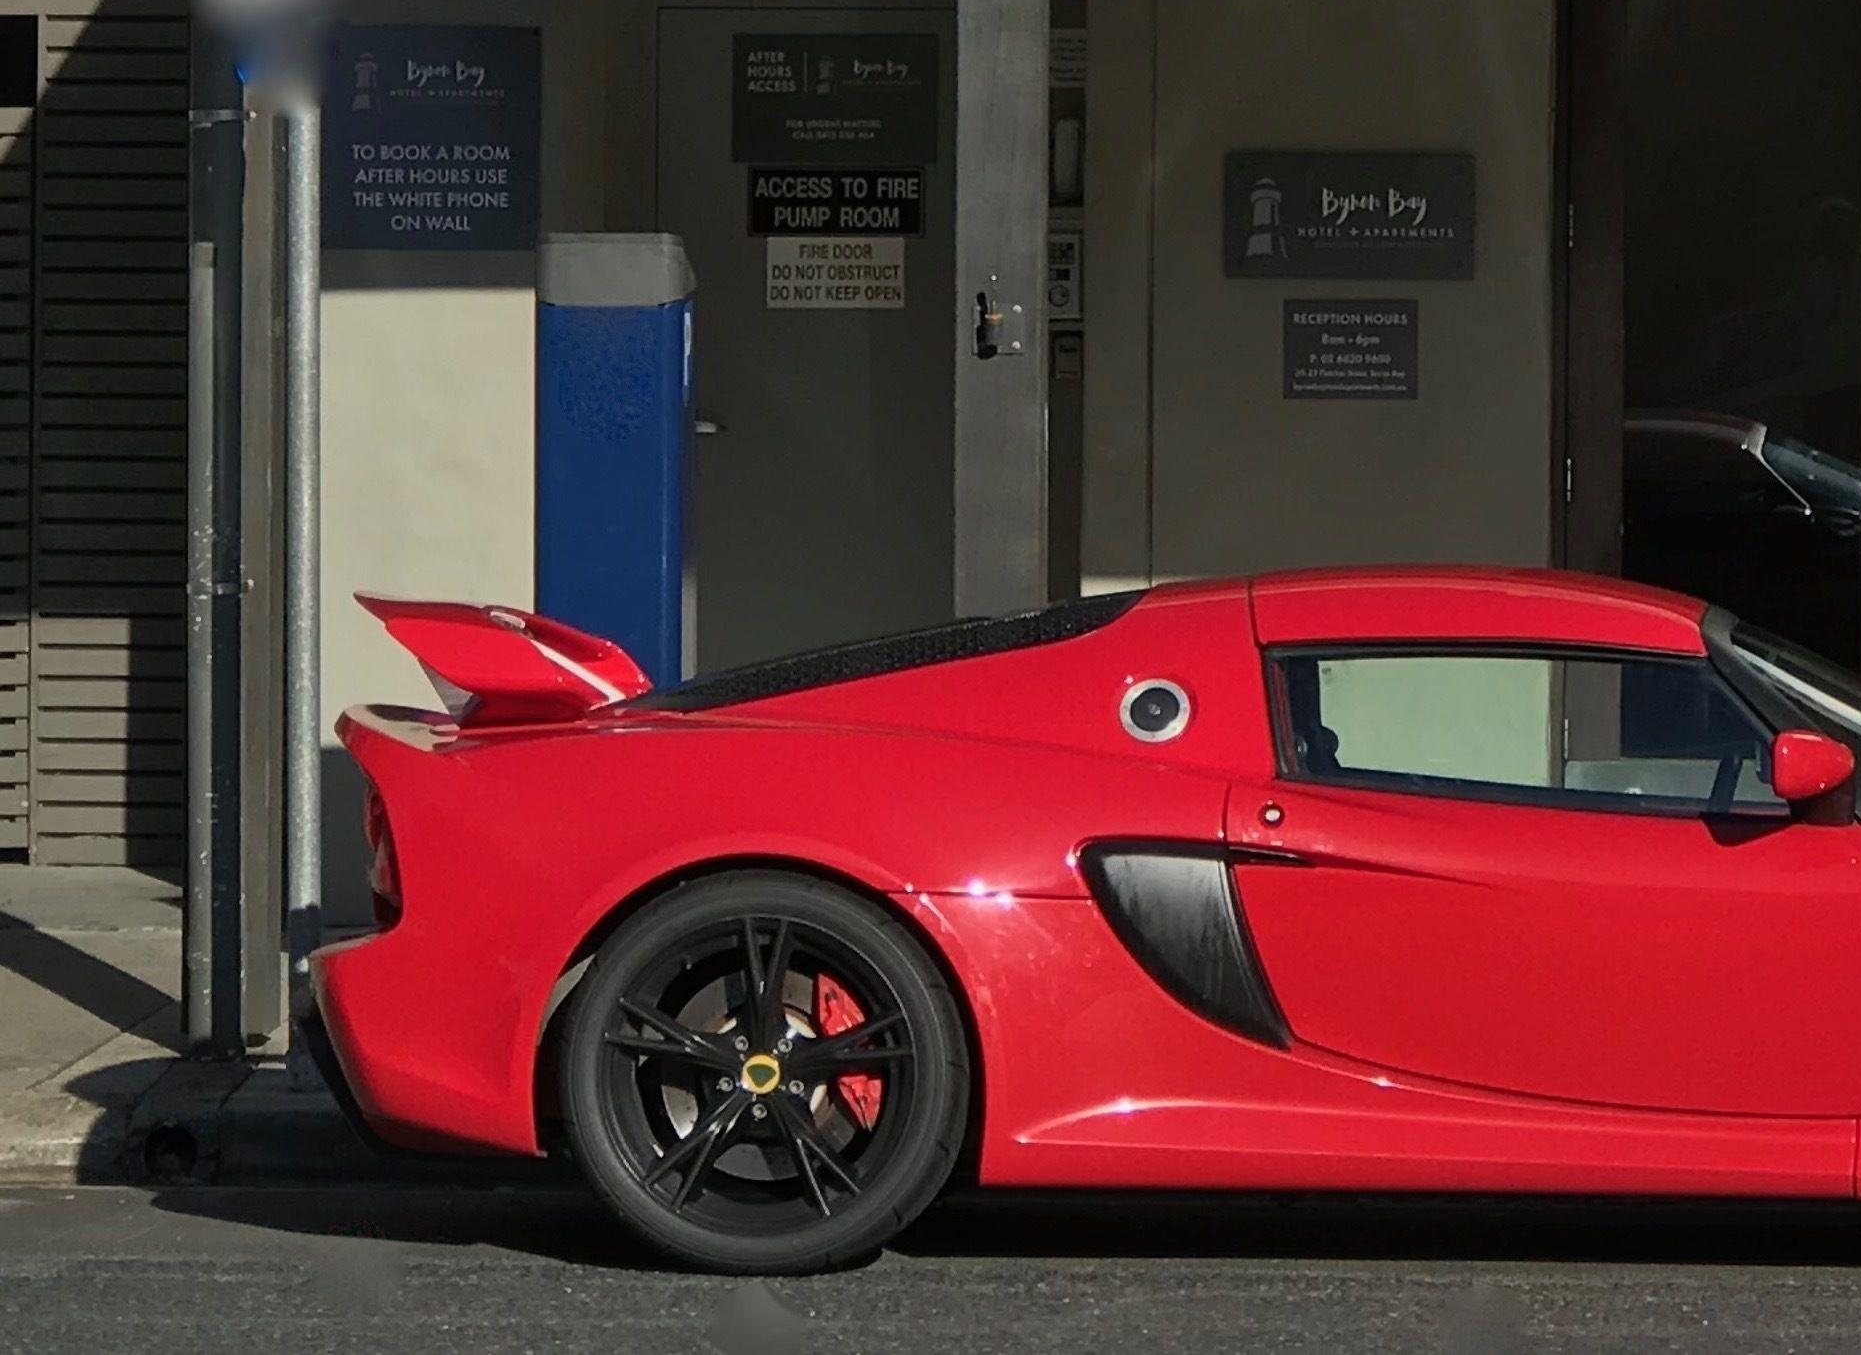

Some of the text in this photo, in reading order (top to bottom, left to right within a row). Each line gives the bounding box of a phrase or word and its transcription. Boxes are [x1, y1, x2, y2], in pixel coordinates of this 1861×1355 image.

[747, 51, 785, 64] AFTER
[747, 65, 792, 78] HOURS
[747, 79, 796, 93] ACCESS
[351, 144, 511, 161] TO BOOK A ROOM
[354, 168, 508, 185] AFTER HOURS USE
[755, 176, 919, 199] ACCESS TO FIRE
[353, 191, 509, 208] THE WHITE PHONE
[1322, 187, 1427, 226] Byron Bay
[390, 214, 471, 231] ON WALL
[774, 206, 900, 228] PUMP ROOM
[799, 243, 873, 260] FIRE DOOR
[771, 264, 901, 281] DO NOT OBSTRUCT
[770, 285, 902, 302] DO NOT KEEP OPEN
[1293, 313, 1408, 325] RECEPTION HOURS
